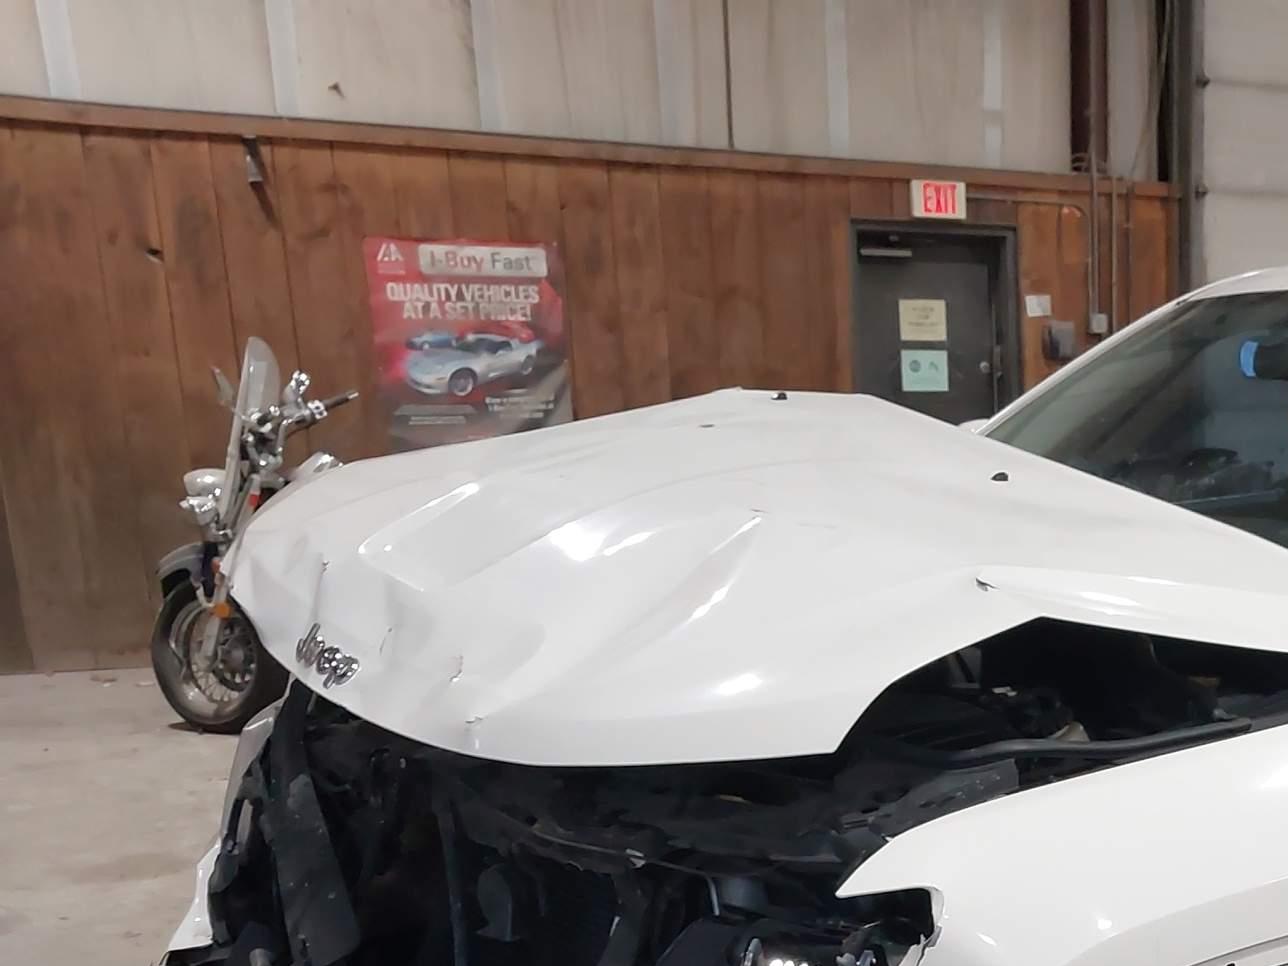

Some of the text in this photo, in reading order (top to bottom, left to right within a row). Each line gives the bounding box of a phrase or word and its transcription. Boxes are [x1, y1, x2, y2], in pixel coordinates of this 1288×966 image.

[923, 182, 957, 214] EXIT
[430, 251, 484, 272] I-Buy
[491, 253, 532, 271] Fast
[386, 282, 539, 303] QUALITY VEHICLES
[403, 303, 424, 319] AT
[429, 304, 442, 319] A
[446, 303, 475, 320] SET
